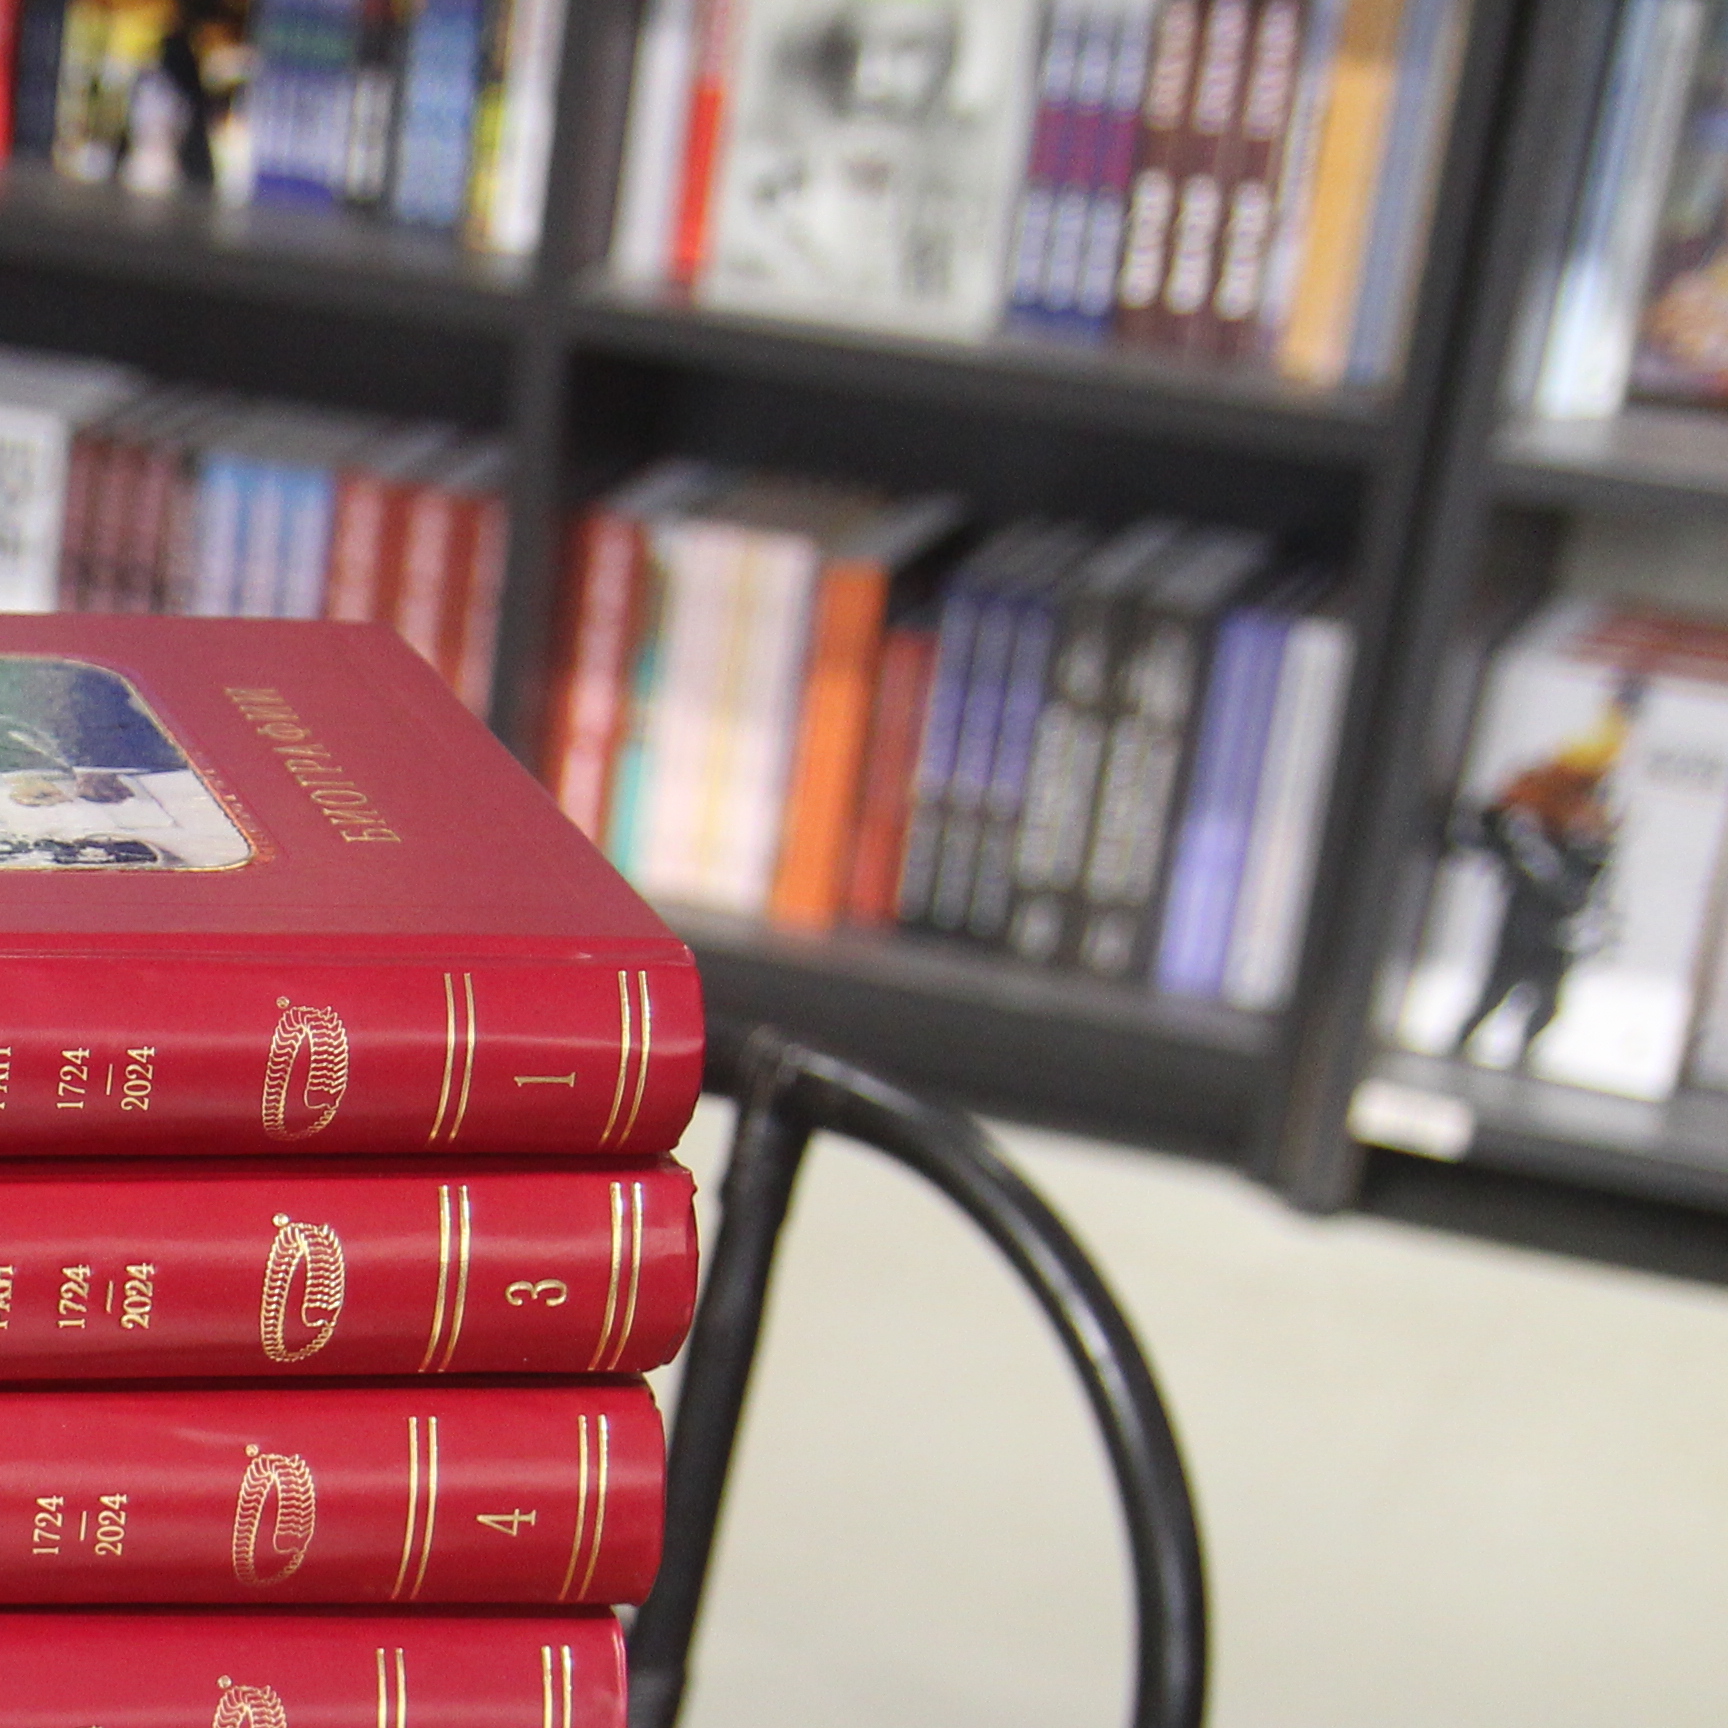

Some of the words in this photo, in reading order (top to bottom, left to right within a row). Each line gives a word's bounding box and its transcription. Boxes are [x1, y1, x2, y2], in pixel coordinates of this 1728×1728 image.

[224, 687, 401, 842] БИОГРАФИИ
[56, 1047, 91, 1111] 1724
[120, 1045, 155, 1111] 2024
[517, 1070, 577, 1089] 1
[57, 1263, 92, 1331] 1724
[120, 1262, 155, 1331] 2024
[505, 1278, 569, 1308] 3
[32, 1494, 64, 1557] 1724
[95, 1492, 127, 1557] 2024
[477, 1508, 538, 1538] 4
